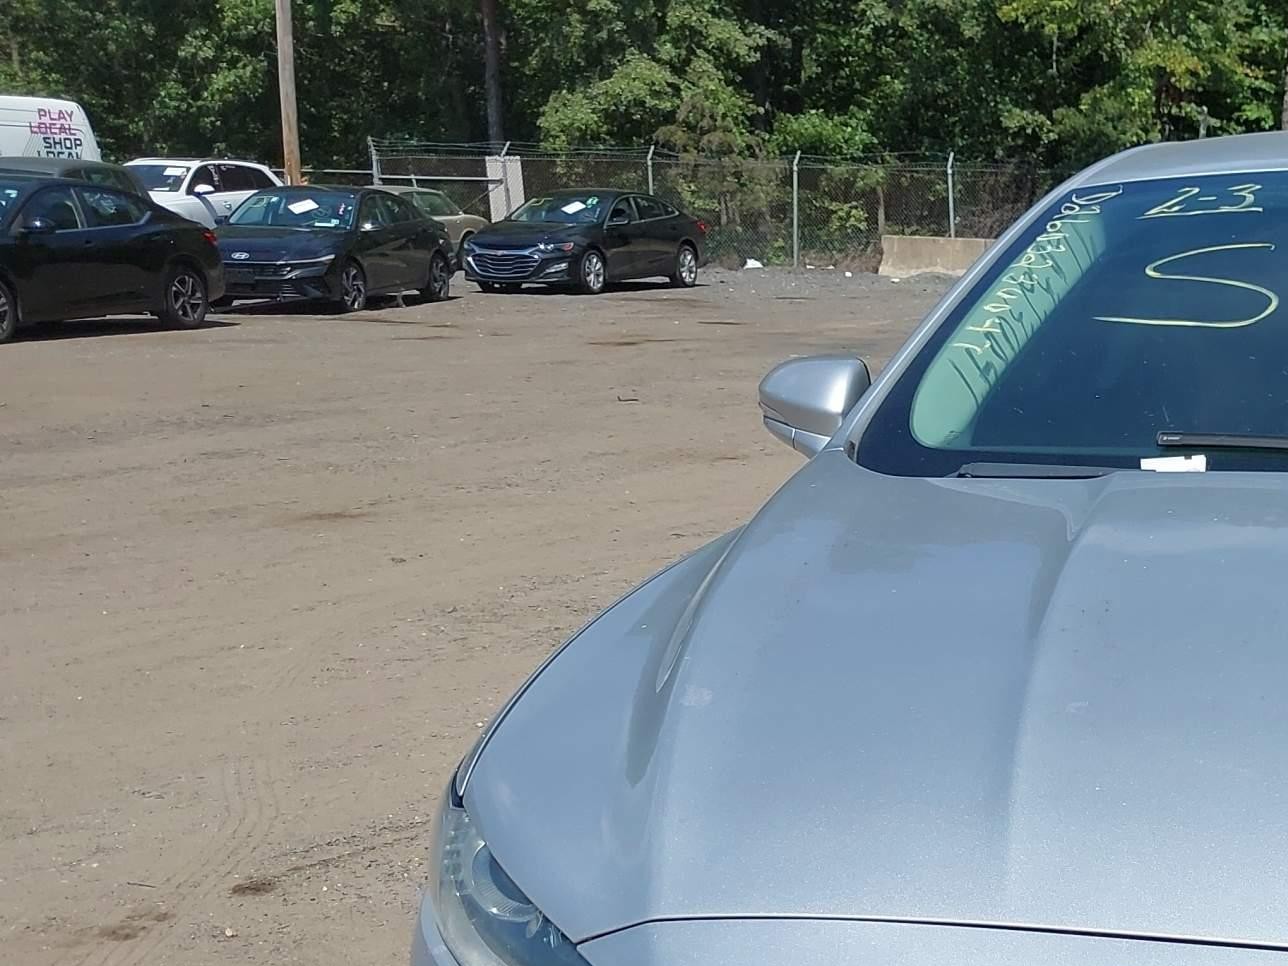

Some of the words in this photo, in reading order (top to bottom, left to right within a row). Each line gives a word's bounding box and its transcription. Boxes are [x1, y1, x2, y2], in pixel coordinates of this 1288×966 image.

[37, 108, 74, 122] PLAY
[29, 122, 77, 136] LOCAL
[42, 136, 83, 150] SHOP
